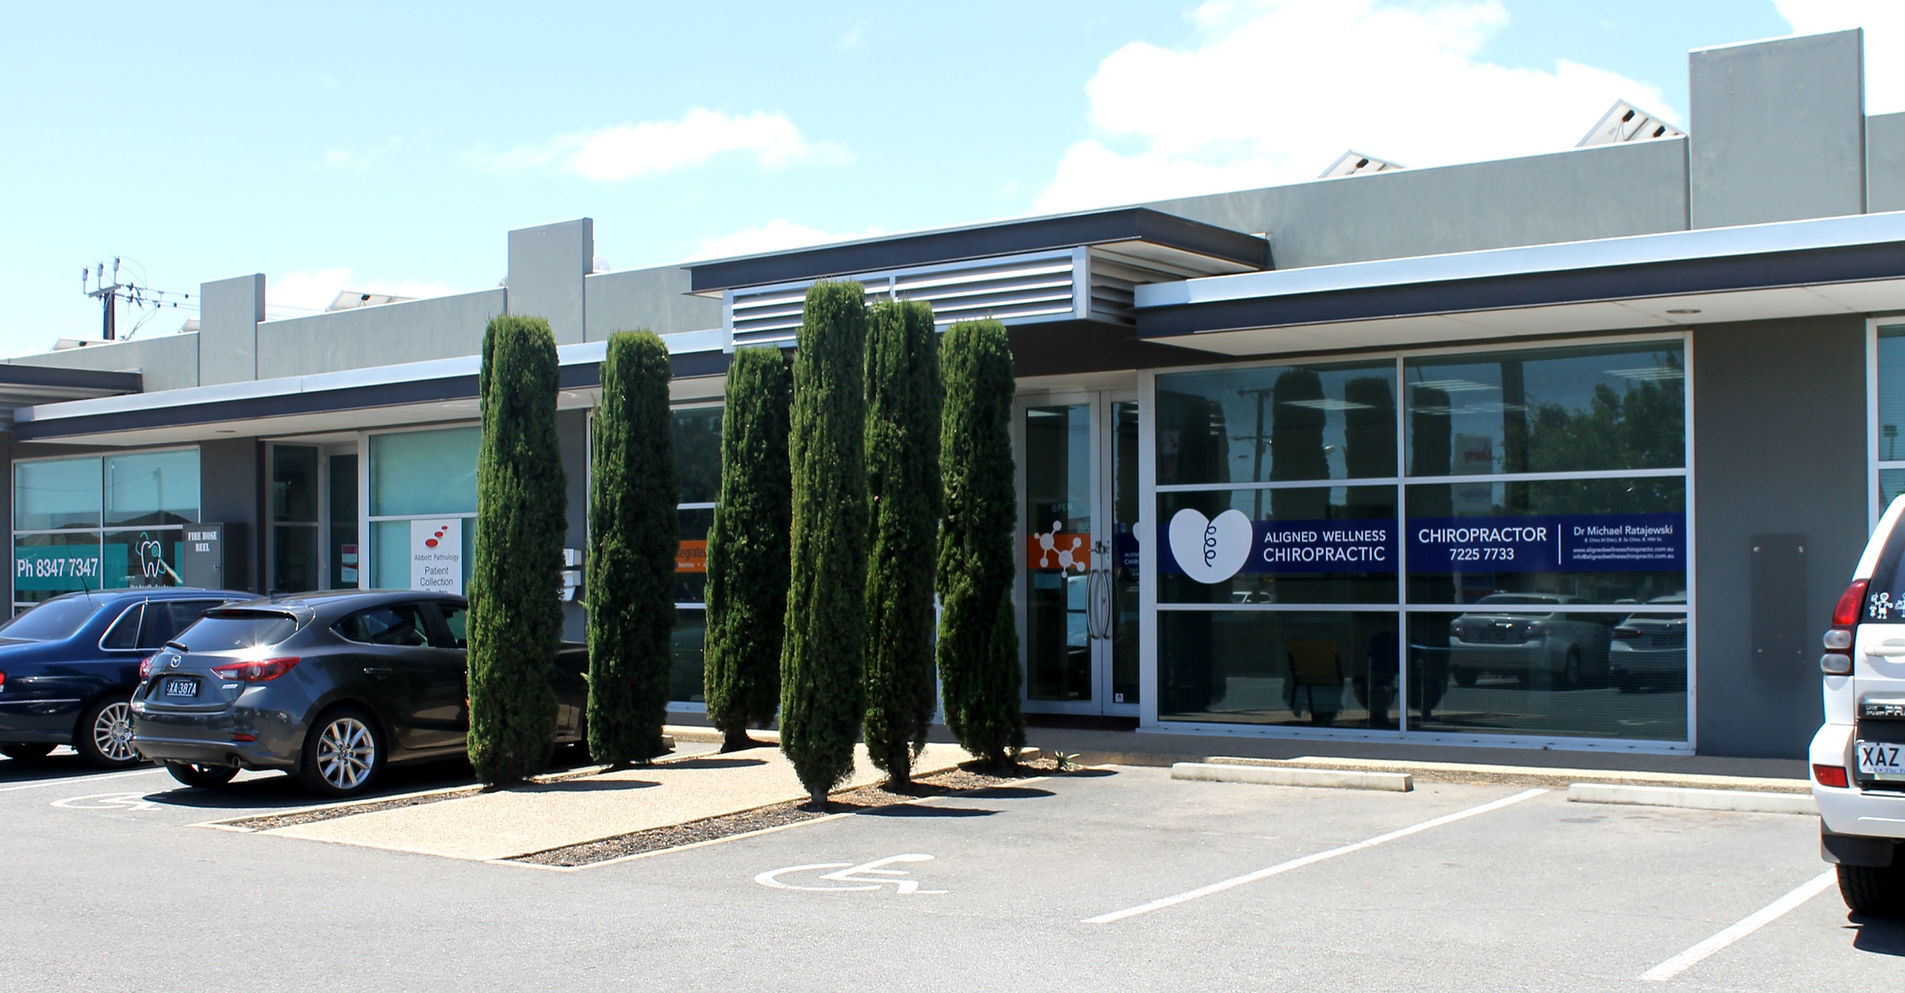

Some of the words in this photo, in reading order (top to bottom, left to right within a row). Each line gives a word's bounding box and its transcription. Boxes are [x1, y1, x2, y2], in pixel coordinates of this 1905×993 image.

[188, 531, 201, 541] FIRE
[202, 531, 218, 541] HOSE
[1264, 532, 1318, 543] ALIGNED
[1322, 530, 1386, 542] WELLNESS
[1418, 527, 1547, 543] CHIROPRACTOR
[1573, 526, 1585, 536] Dr
[1587, 526, 1622, 535] Michael
[1625, 525, 1673, 537] Ratajewski
[195, 543, 210, 552] REEL
[414, 553, 432, 561] Abbott
[433, 553, 459, 562] Pathology
[1263, 546, 1386, 562] CHIROPRACTIC
[1449, 548, 1480, 561] 7225
[1483, 547, 1515, 560] 7733
[17, 559, 33, 578] Ph
[36, 559, 65, 578] 8347
[69, 558, 98, 577] 7347
[424, 566, 449, 575] Patient
[420, 577, 454, 586] Collection
[1862, 746, 1900, 767] XAZ
